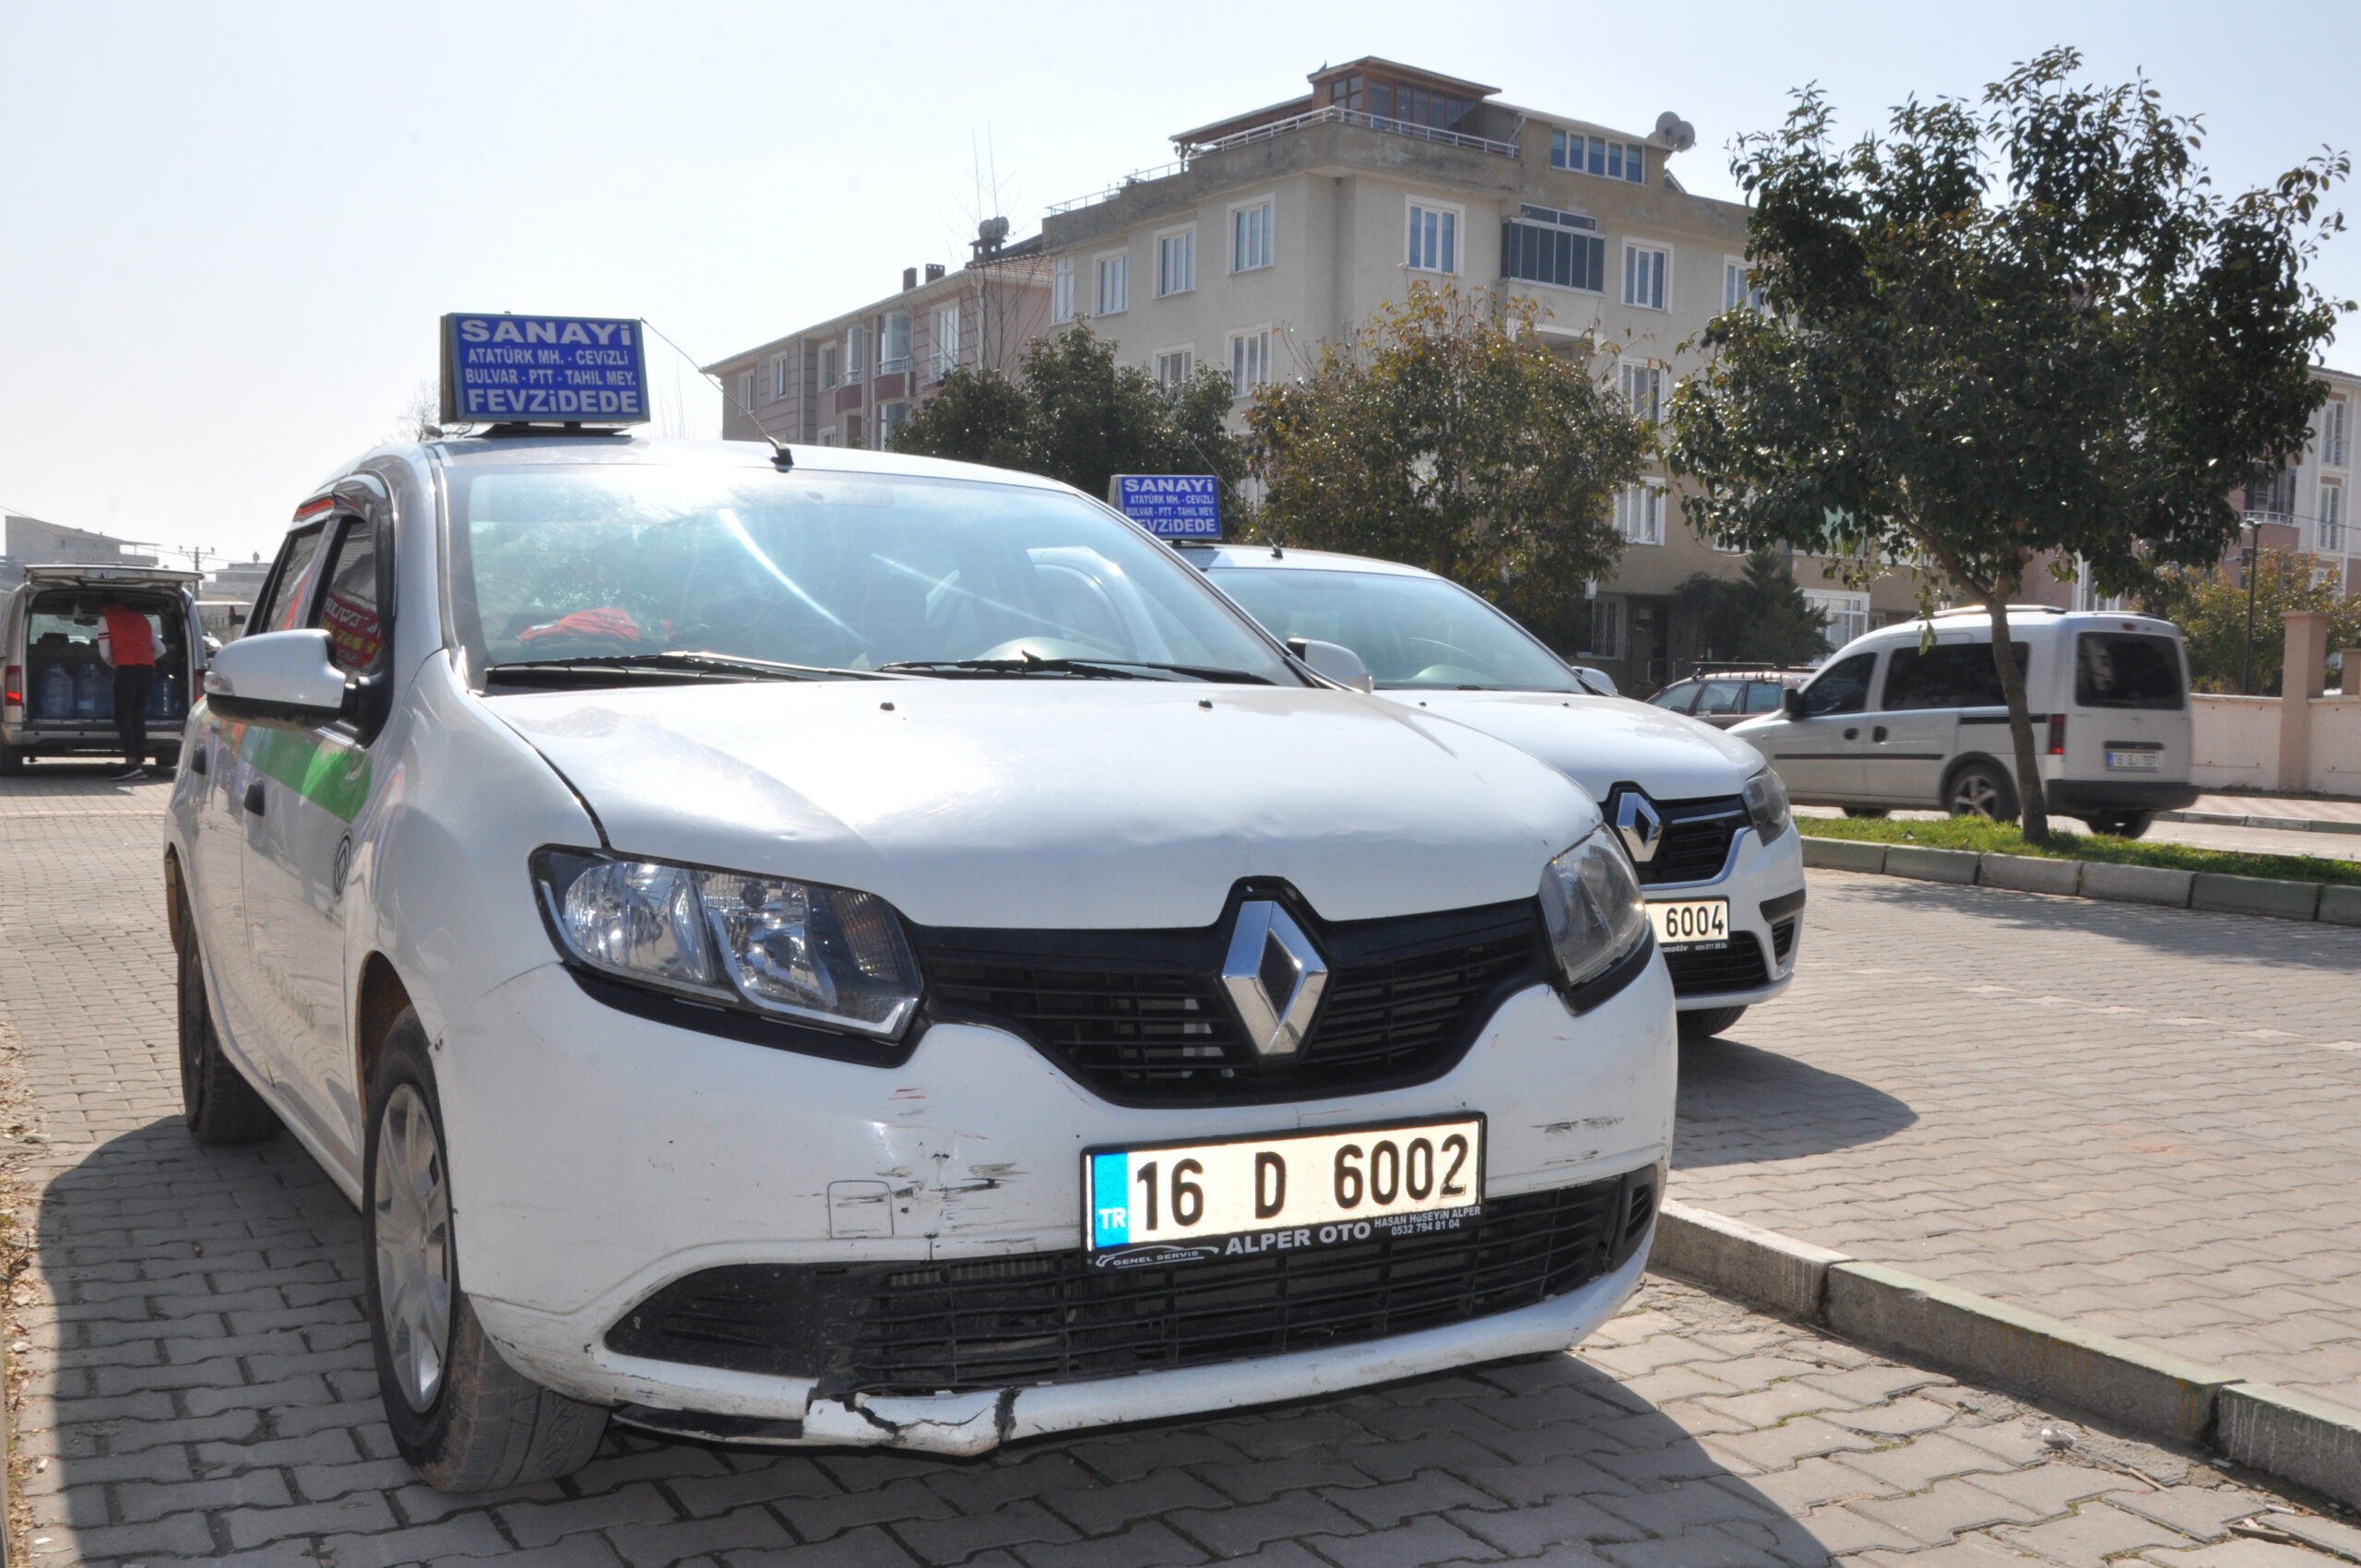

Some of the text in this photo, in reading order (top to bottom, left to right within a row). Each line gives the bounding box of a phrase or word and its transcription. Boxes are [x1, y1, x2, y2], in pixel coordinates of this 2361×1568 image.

[469, 345, 534, 363] ATATÜRK
[537, 350, 564, 364] MH.
[465, 368, 518, 384] BULVAR
[528, 369, 553, 385] PTT
[564, 370, 603, 386] TAHIL
[606, 371, 635, 386] MEY.
[1130, 493, 1164, 505] ATATÜRK
[1166, 495, 1180, 505] MH.
[1125, 506, 1154, 517] BULVAR
[1158, 507, 1172, 517] PTT
[1177, 507, 1198, 517] TAHIL
[1199, 507, 1216, 517] MEY.
[1666, 905, 1724, 937] 6004
[1098, 1134, 1469, 1230] TR 16 D 6002
[1374, 1216, 1406, 1229] HASAN
[1452, 1206, 1481, 1218] ALPER
[1391, 1219, 1460, 1236] 0532 794 81 04
[1225, 1221, 1371, 1255] ALPER OTO
[1113, 1255, 1154, 1266] GENEL
